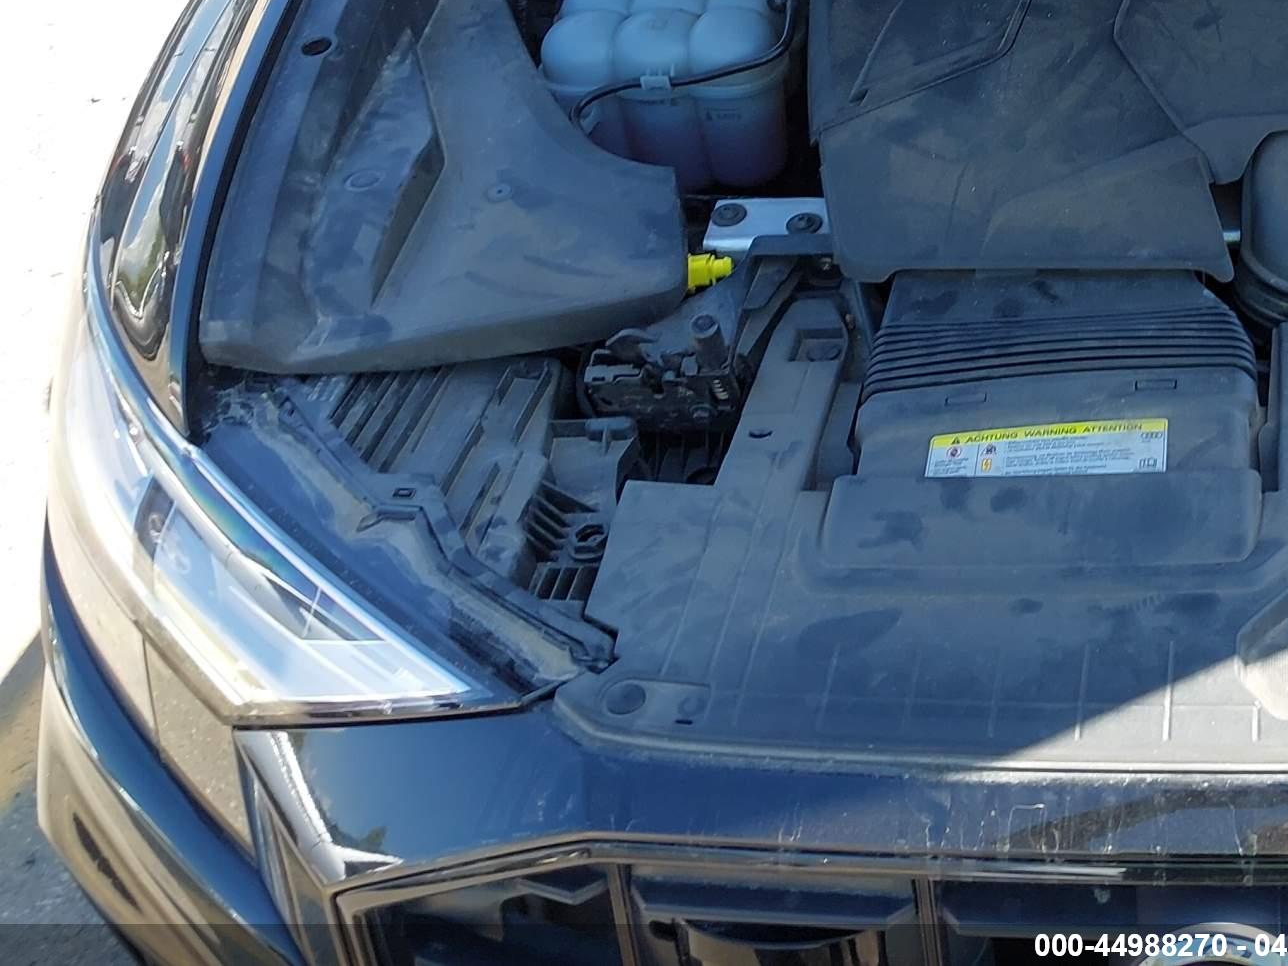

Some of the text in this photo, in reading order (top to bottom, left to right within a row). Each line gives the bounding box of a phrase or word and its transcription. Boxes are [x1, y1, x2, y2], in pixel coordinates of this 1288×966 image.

[965, 423, 1142, 443] ACHTUNG WARNING ATTENTION
